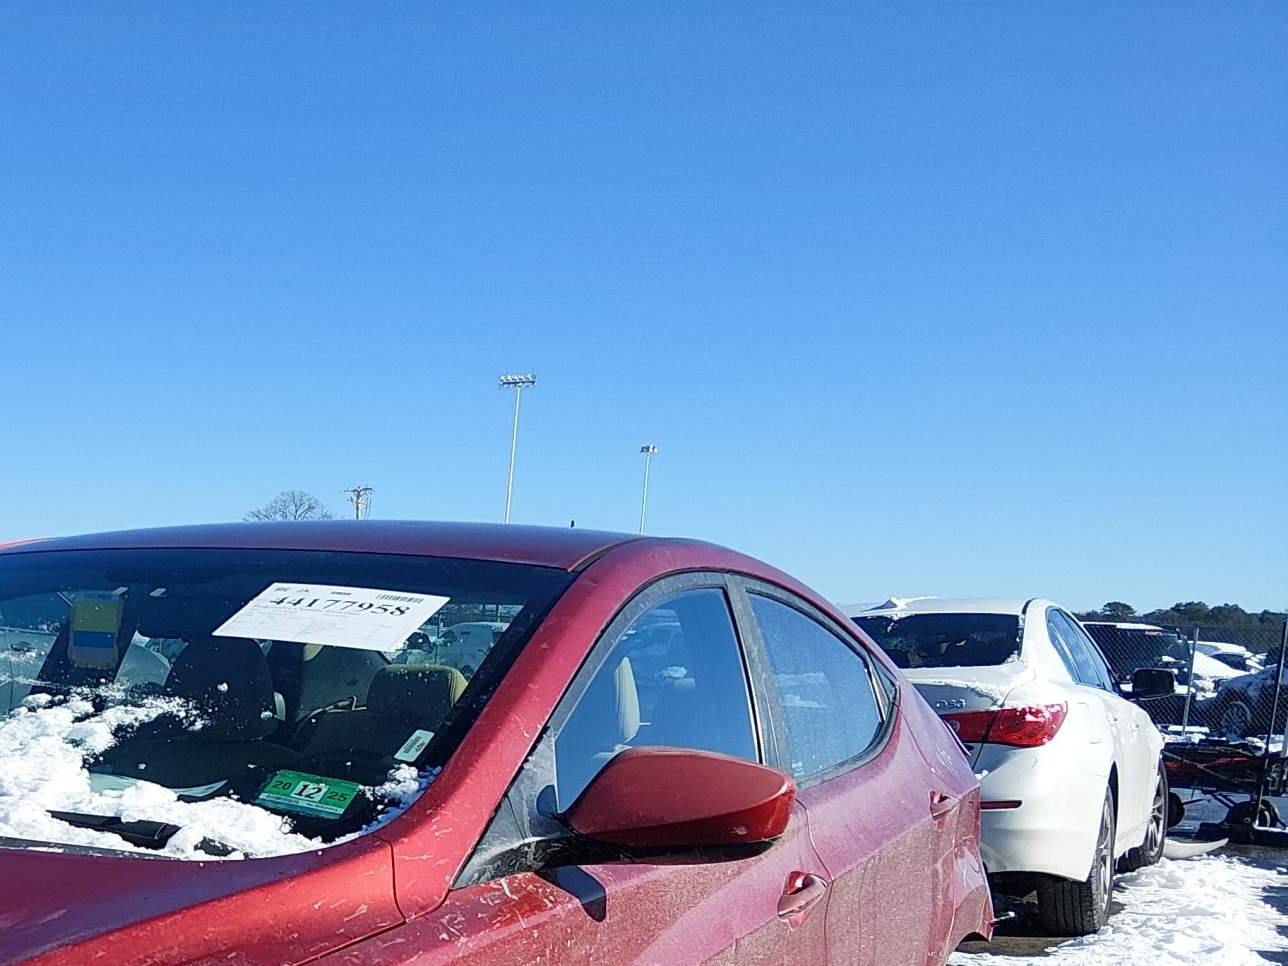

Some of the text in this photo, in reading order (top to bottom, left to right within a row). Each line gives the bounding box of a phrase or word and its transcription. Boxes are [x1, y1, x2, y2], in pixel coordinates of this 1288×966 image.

[269, 594, 412, 617] 44177958
[272, 780, 350, 802] 20 12 25
